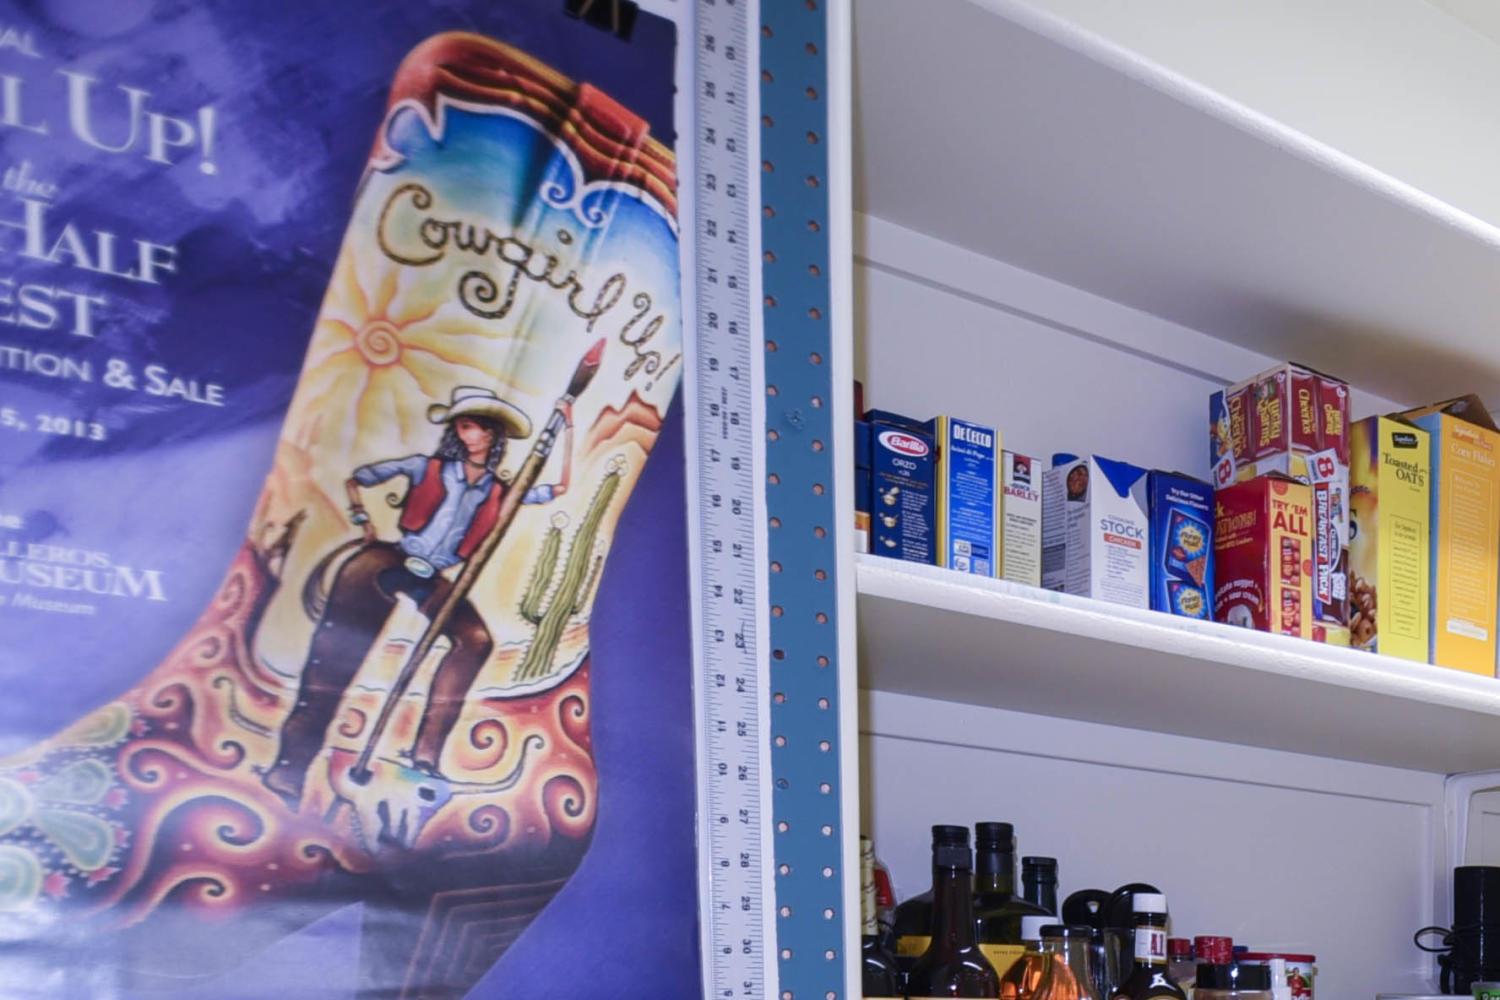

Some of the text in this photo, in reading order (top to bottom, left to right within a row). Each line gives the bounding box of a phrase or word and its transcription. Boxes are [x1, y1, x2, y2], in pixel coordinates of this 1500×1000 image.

[377, 183, 680, 391] Cowgirl Up!
[103, 358, 136, 391] &
[36, 413, 107, 441] 2013
[891, 436, 924, 452] Barilla
[1317, 457, 1334, 478] 8
[1382, 453, 1419, 473] Toasted
[1395, 468, 1424, 487] OATS
[1004, 486, 1039, 501] BARLEY
[1273, 500, 1308, 516] TRY 'EM
[1100, 519, 1144, 539] STOCK
[1273, 511, 1308, 536] ALL
[1316, 489, 1329, 597] BREAKFAST PACK
[0, 540, 110, 568] LEROS
